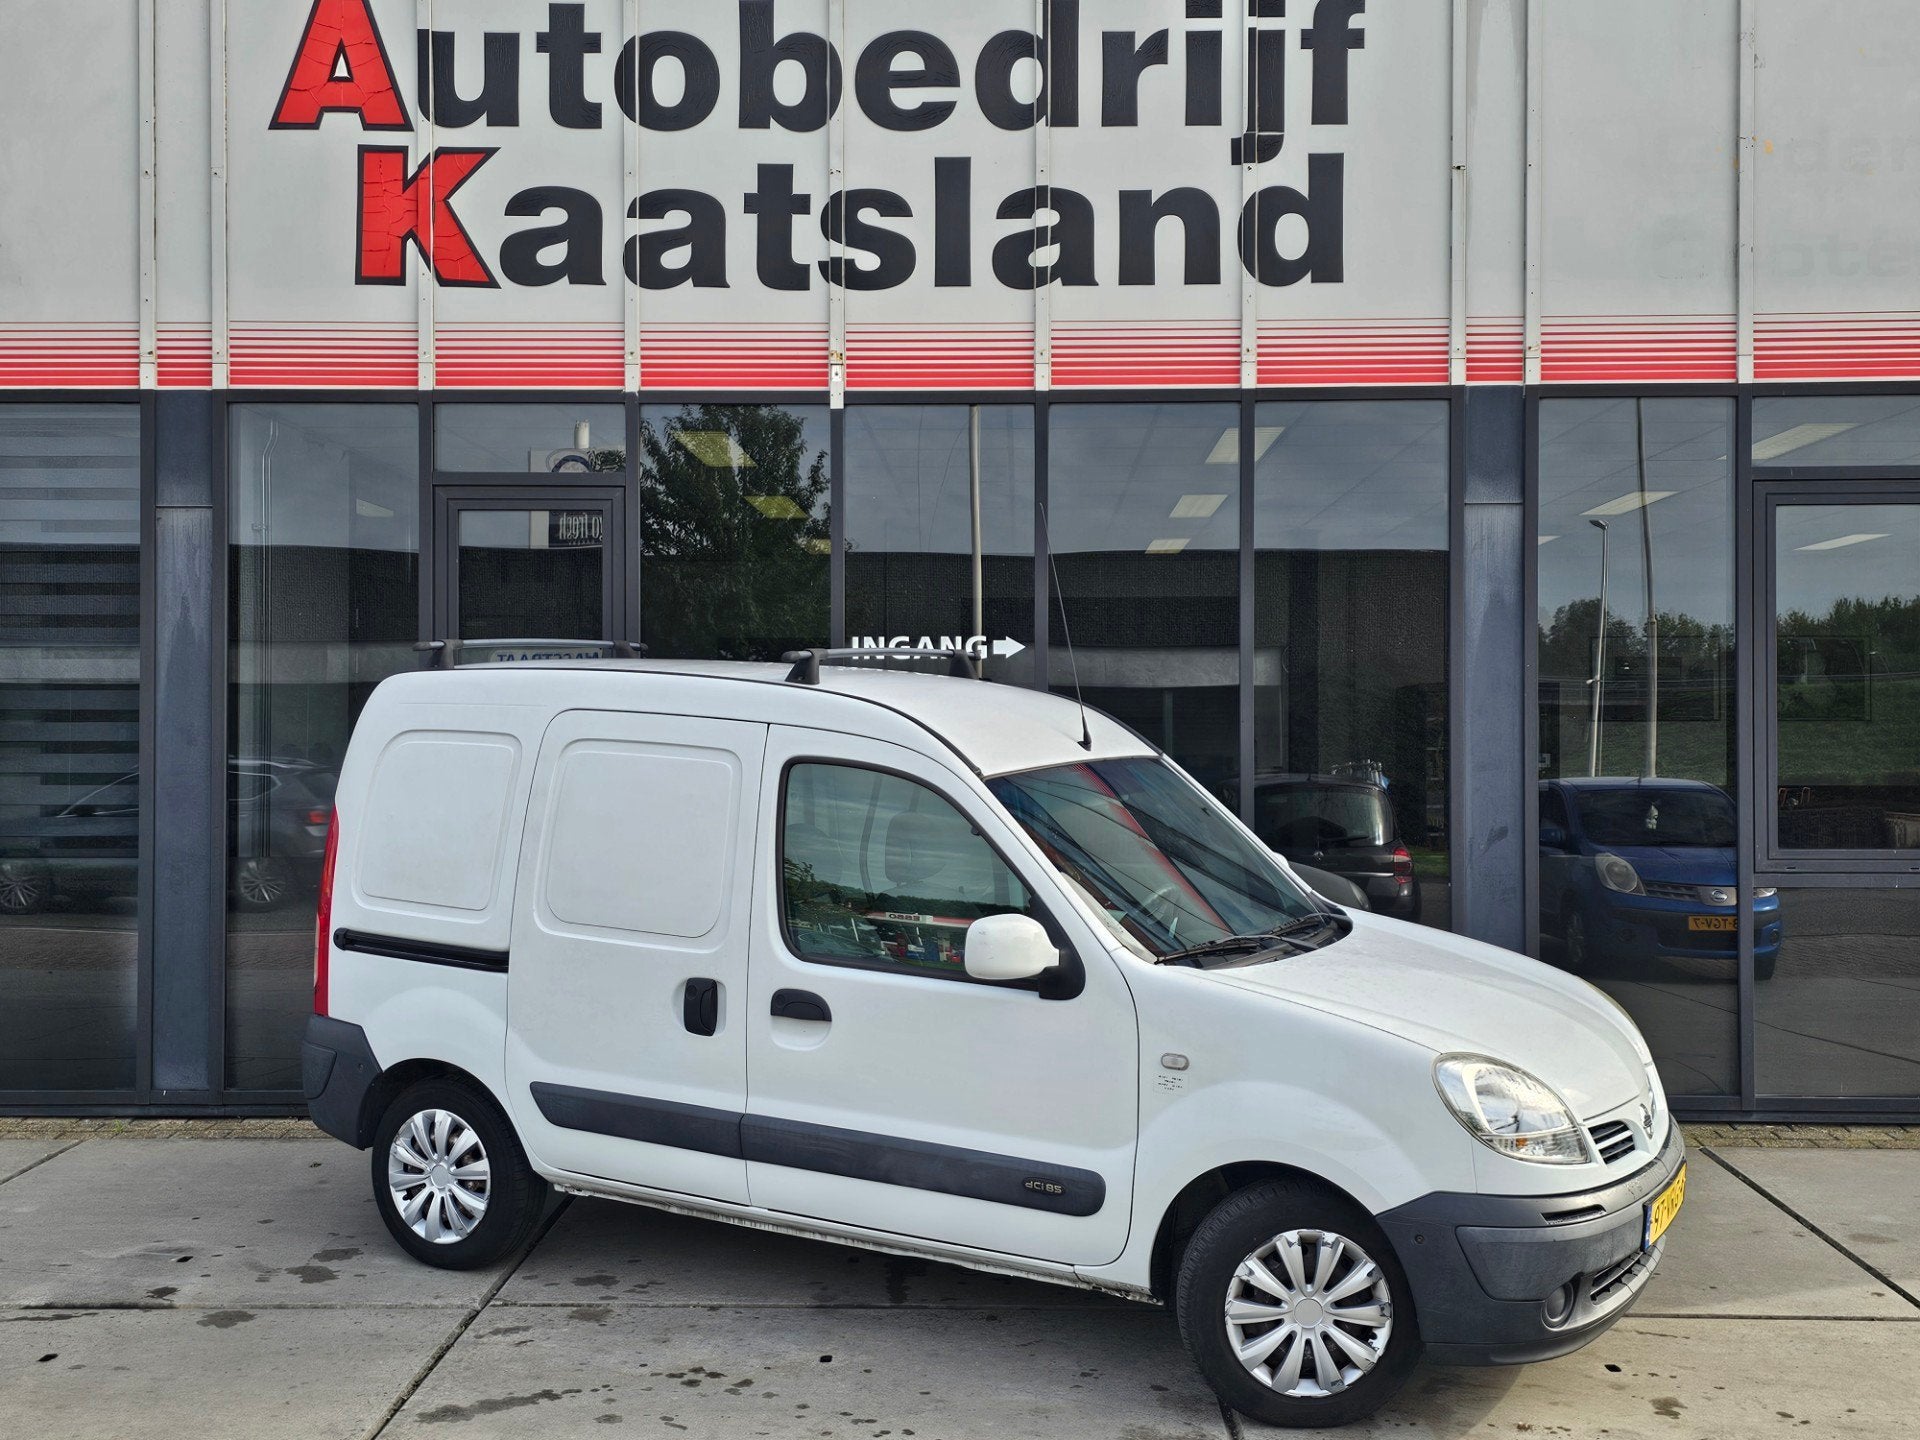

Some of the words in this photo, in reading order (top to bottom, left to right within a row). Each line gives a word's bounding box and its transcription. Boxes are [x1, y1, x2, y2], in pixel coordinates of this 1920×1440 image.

[268, 0, 1366, 165] Autobedrijf
[355, 144, 1344, 291] Kaatsland
[851, 635, 988, 660] INGANG
[1046, 1183, 1062, 1194] 85
